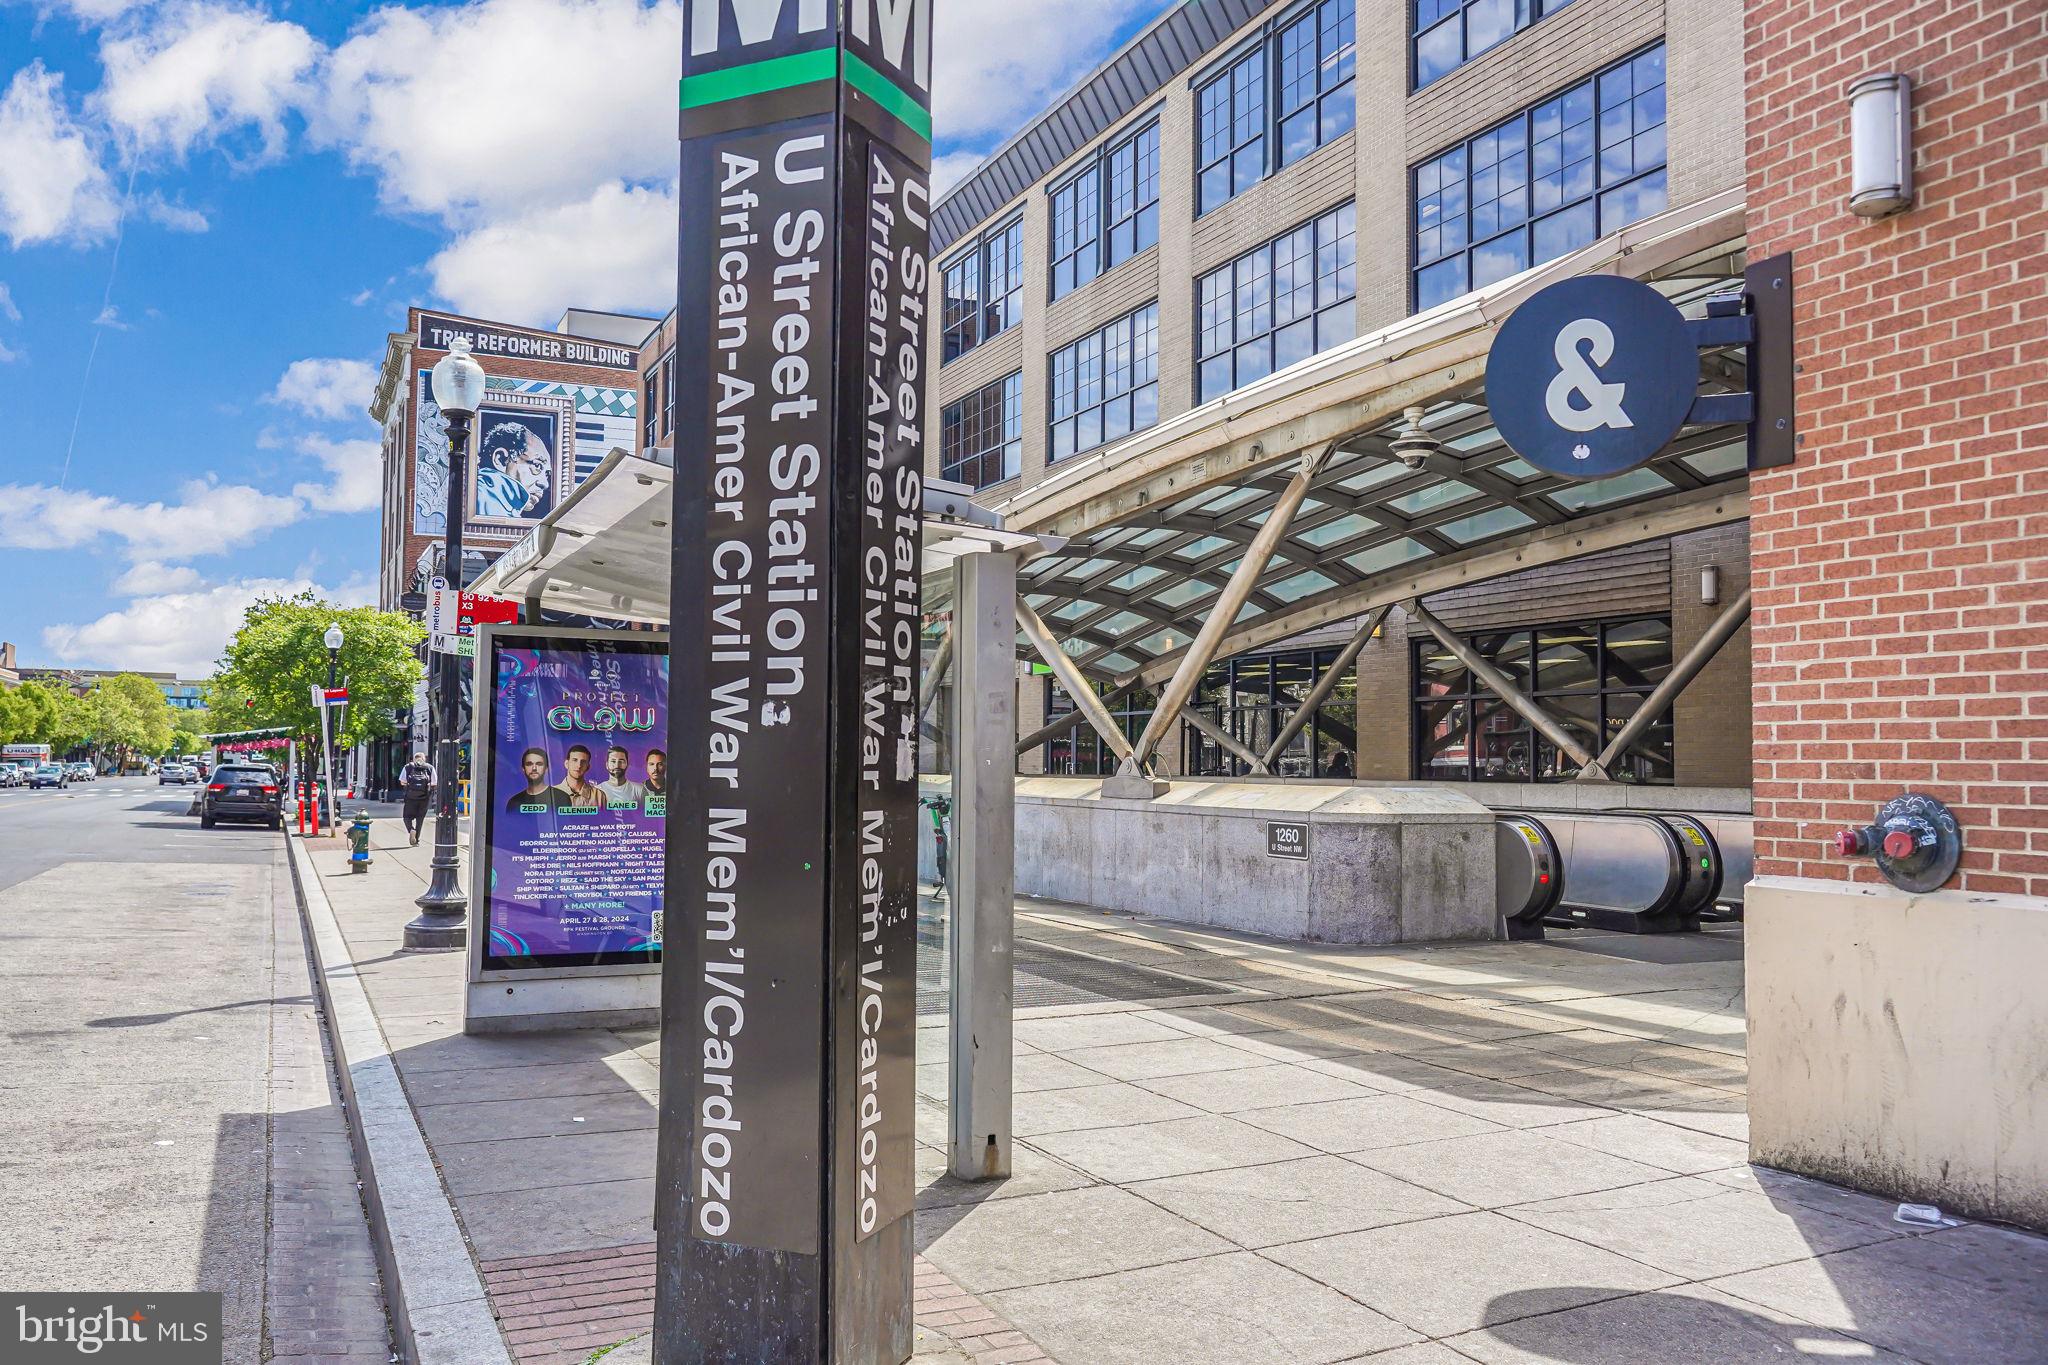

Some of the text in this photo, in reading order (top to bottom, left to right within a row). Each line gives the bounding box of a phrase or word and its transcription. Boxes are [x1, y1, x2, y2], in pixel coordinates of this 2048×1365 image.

[478, 333, 561, 358] REFORMER
[566, 343, 630, 366] BUILDING
[715, 152, 760, 522] African-Amer
[867, 154, 896, 530] African-Amer
[767, 135, 825, 696] U Street Station
[894, 179, 928, 702] U Street Station
[433, 591, 441, 631] metrobus
[434, 635, 445, 647] M
[712, 541, 753, 662] Civil
[865, 547, 888, 667] Civil
[547, 705, 655, 732] GLOW
[710, 677, 750, 789] War
[864, 683, 886, 791] War
[1275, 828, 1299, 843] 1260
[1277, 844, 1293, 852] Street
